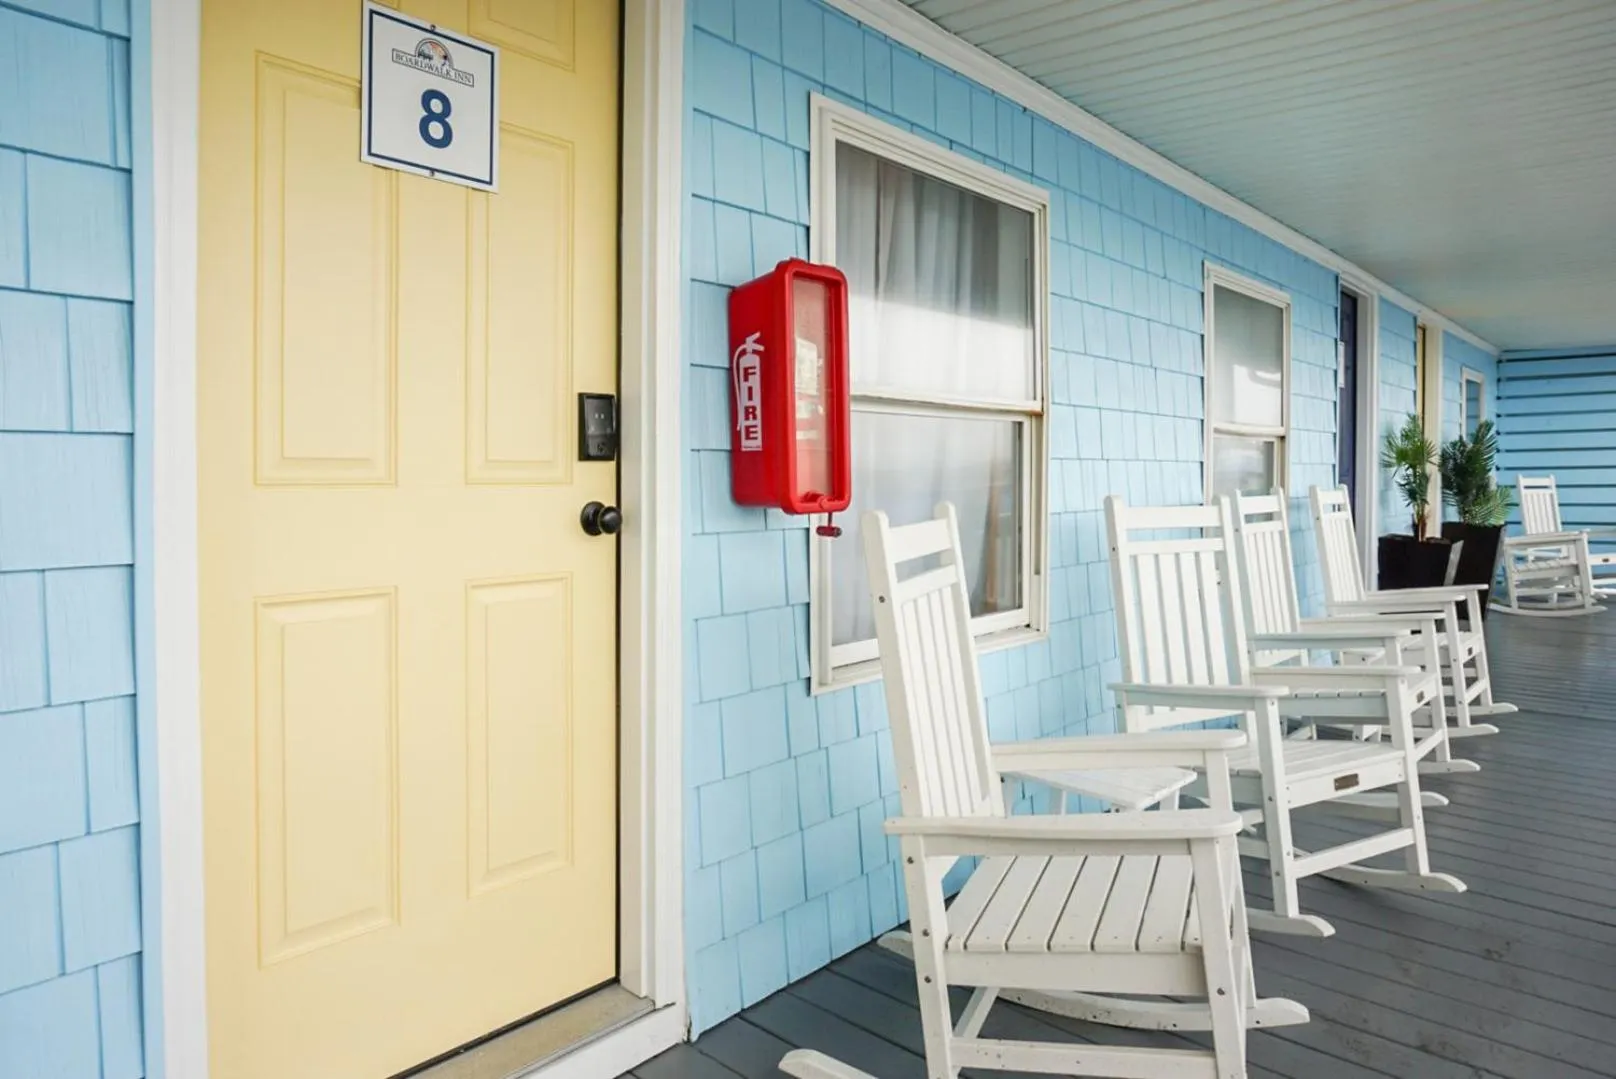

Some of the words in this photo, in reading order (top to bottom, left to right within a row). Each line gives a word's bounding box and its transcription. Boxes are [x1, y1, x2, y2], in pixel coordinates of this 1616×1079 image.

[395, 52, 452, 77] BOARDWALK
[454, 70, 472, 84] INN
[419, 88, 453, 149] 8
[743, 366, 758, 440] FIRE
